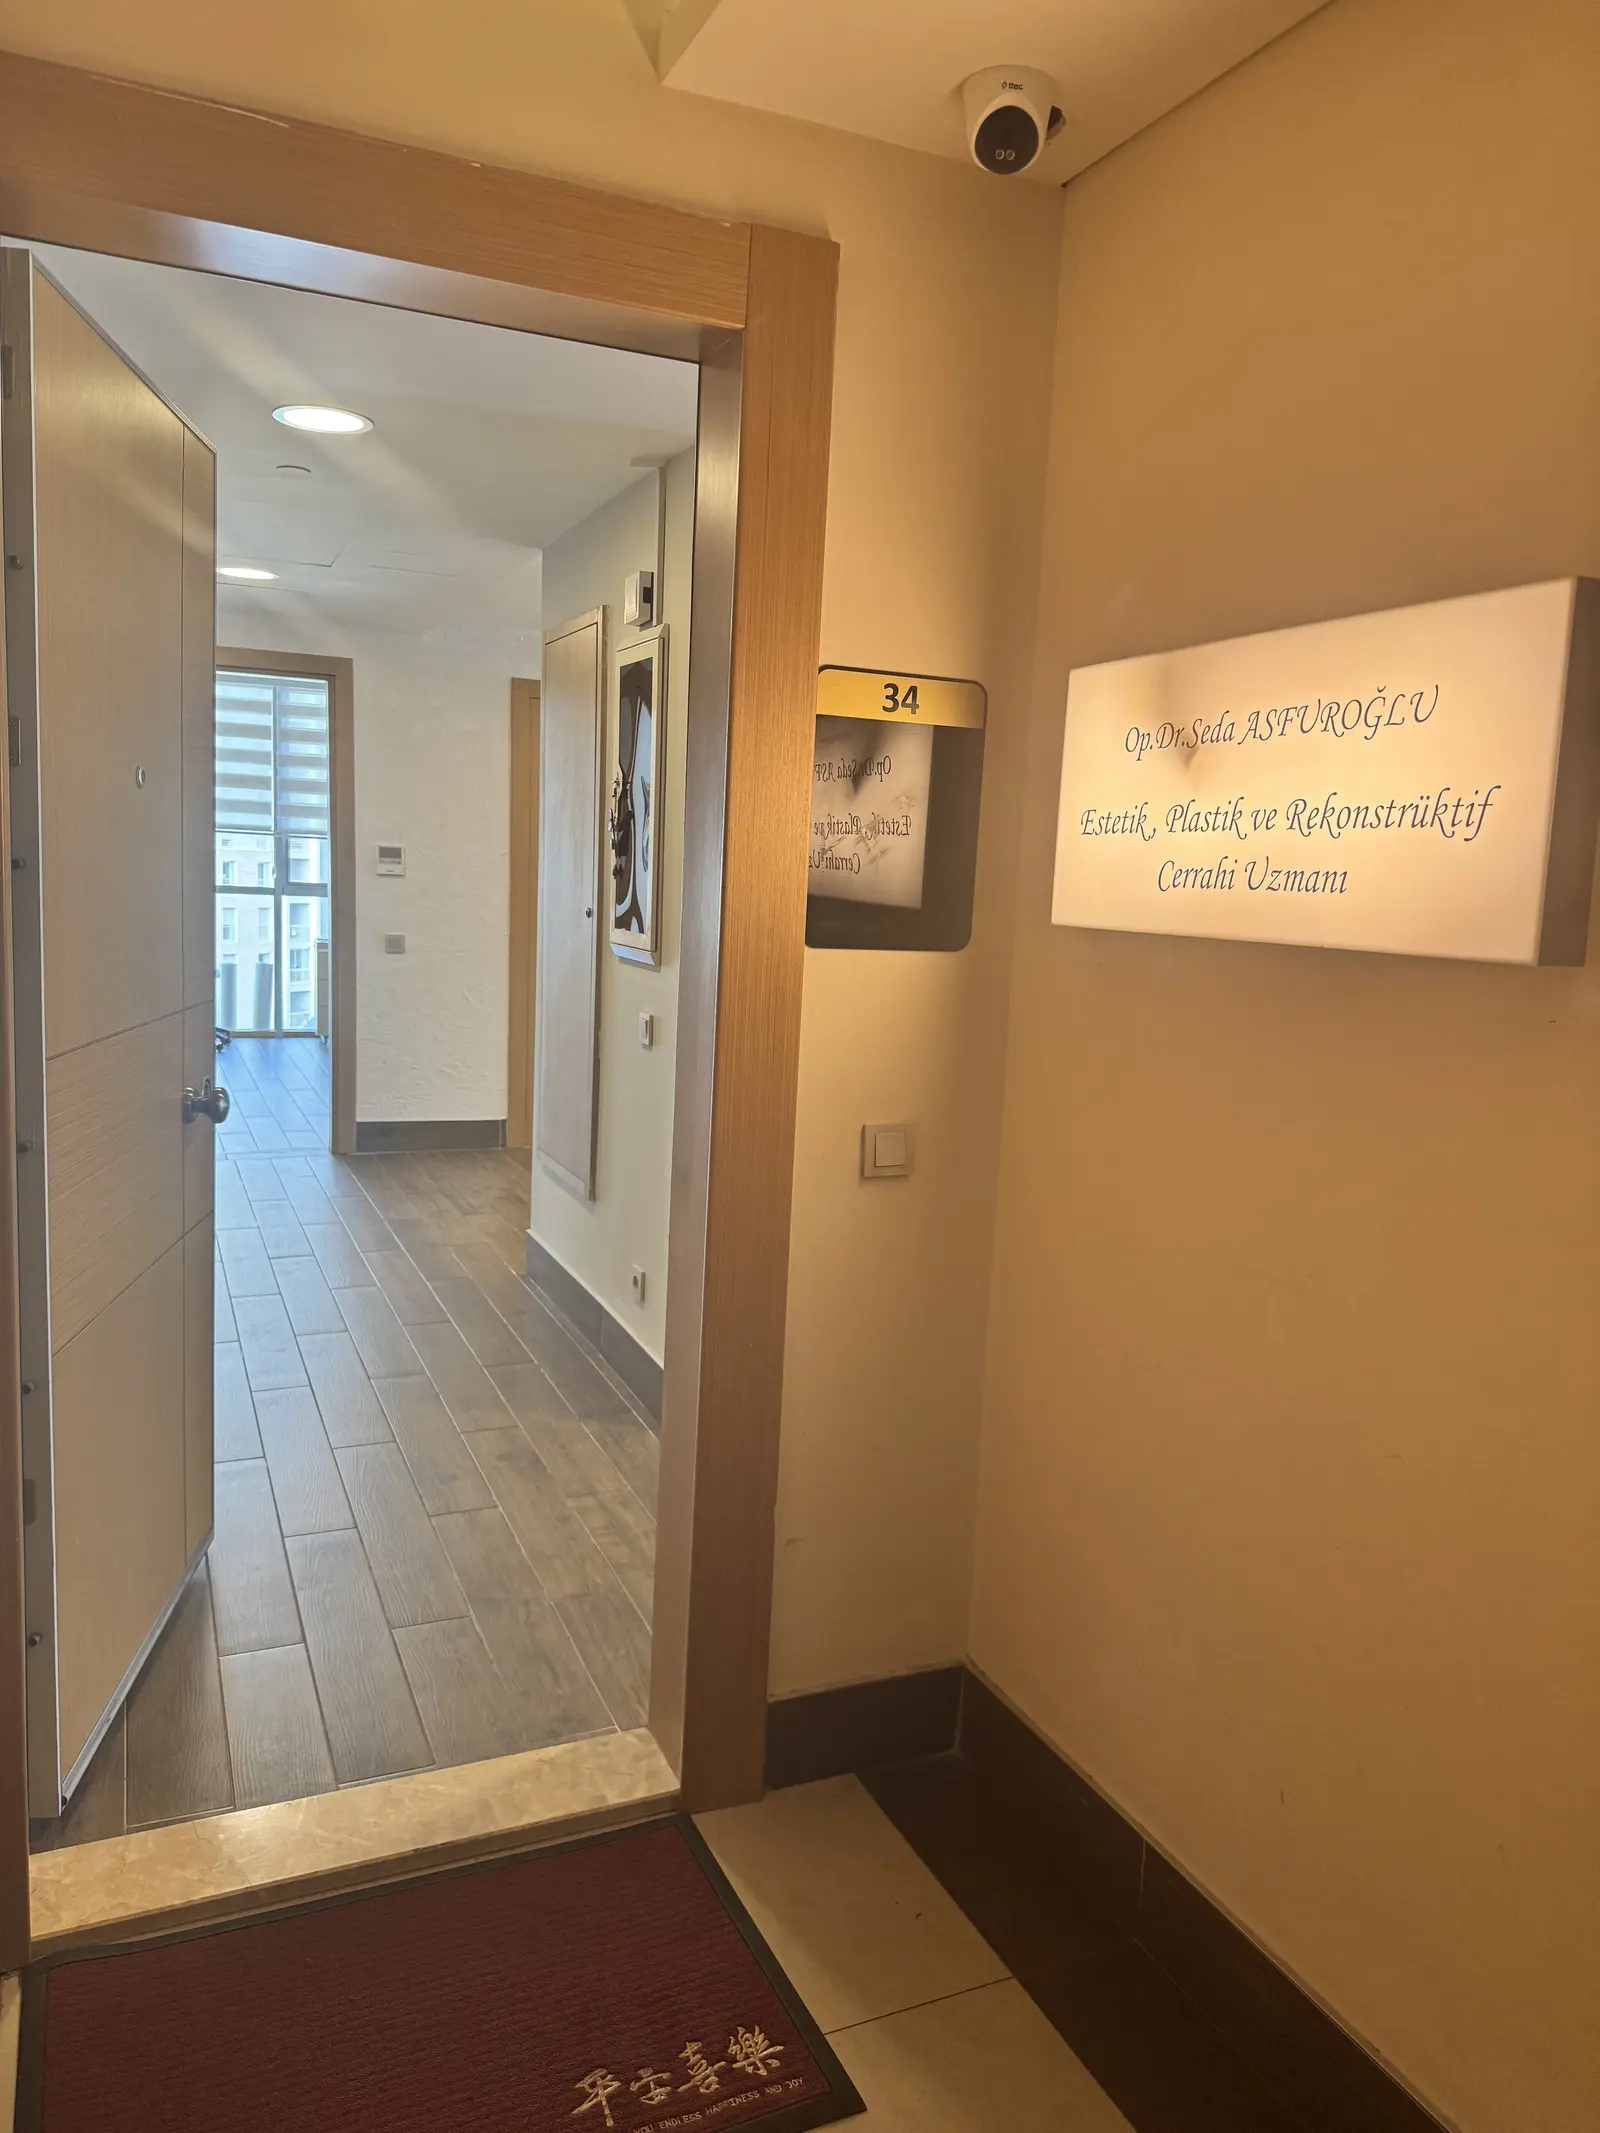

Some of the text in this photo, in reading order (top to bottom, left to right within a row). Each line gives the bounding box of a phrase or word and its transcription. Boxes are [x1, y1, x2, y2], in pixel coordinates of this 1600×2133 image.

[882, 683, 919, 715] 34
[1237, 685, 1440, 745] ASFUROĞLU
[1080, 785, 1502, 842] Estetik, Plastik ve Rekonstrüktif
[1157, 856, 1349, 895] Cerrahi Uzmanı
[764, 2084, 783, 2096] AND
[785, 2077, 804, 2090] JOY
